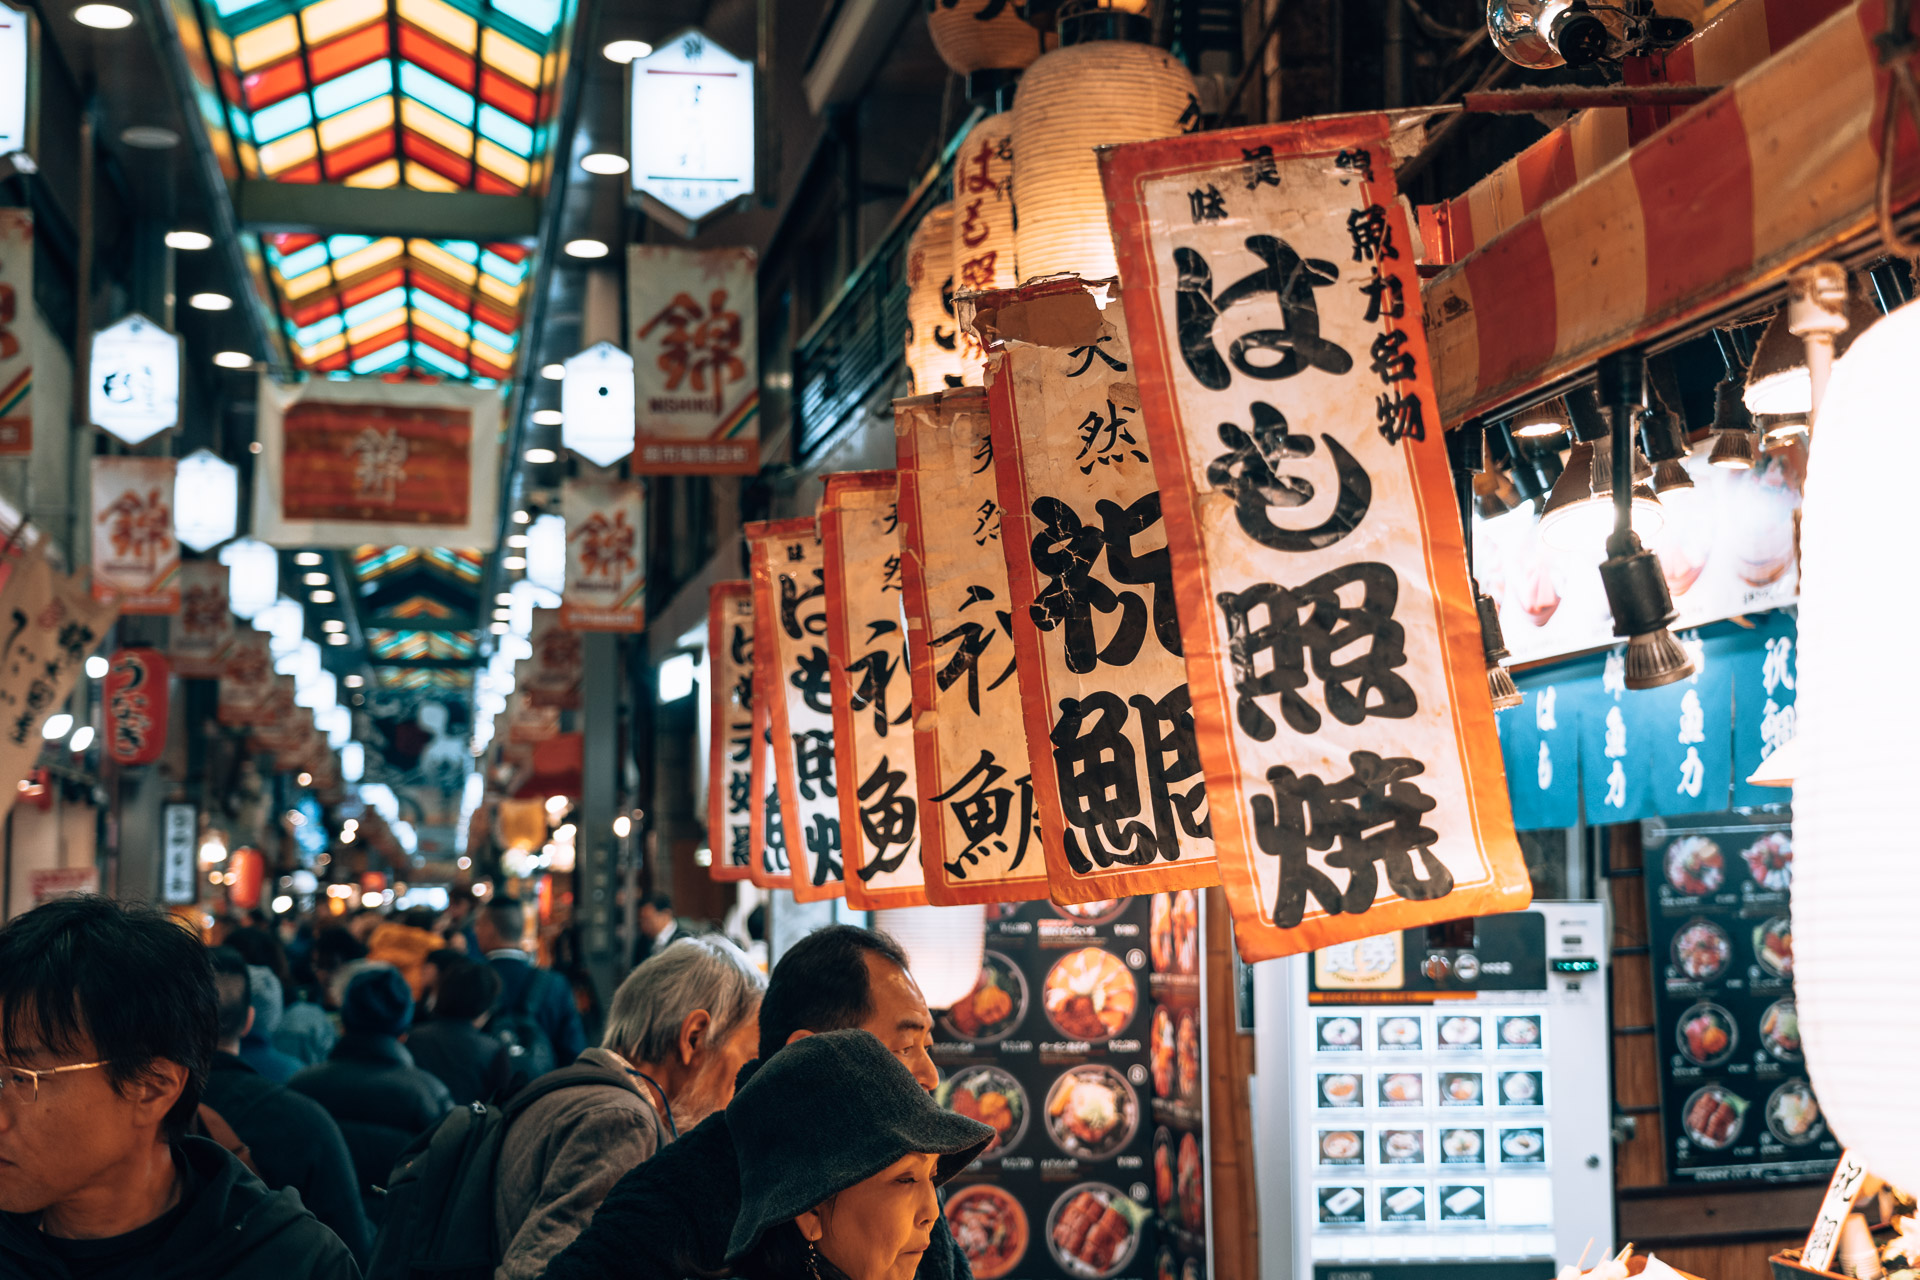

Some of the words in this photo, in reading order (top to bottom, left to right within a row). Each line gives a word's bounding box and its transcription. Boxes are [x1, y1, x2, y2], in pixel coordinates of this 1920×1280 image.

[636, 289, 746, 416] 錦
[1173, 235, 1454, 928] はも照焼
